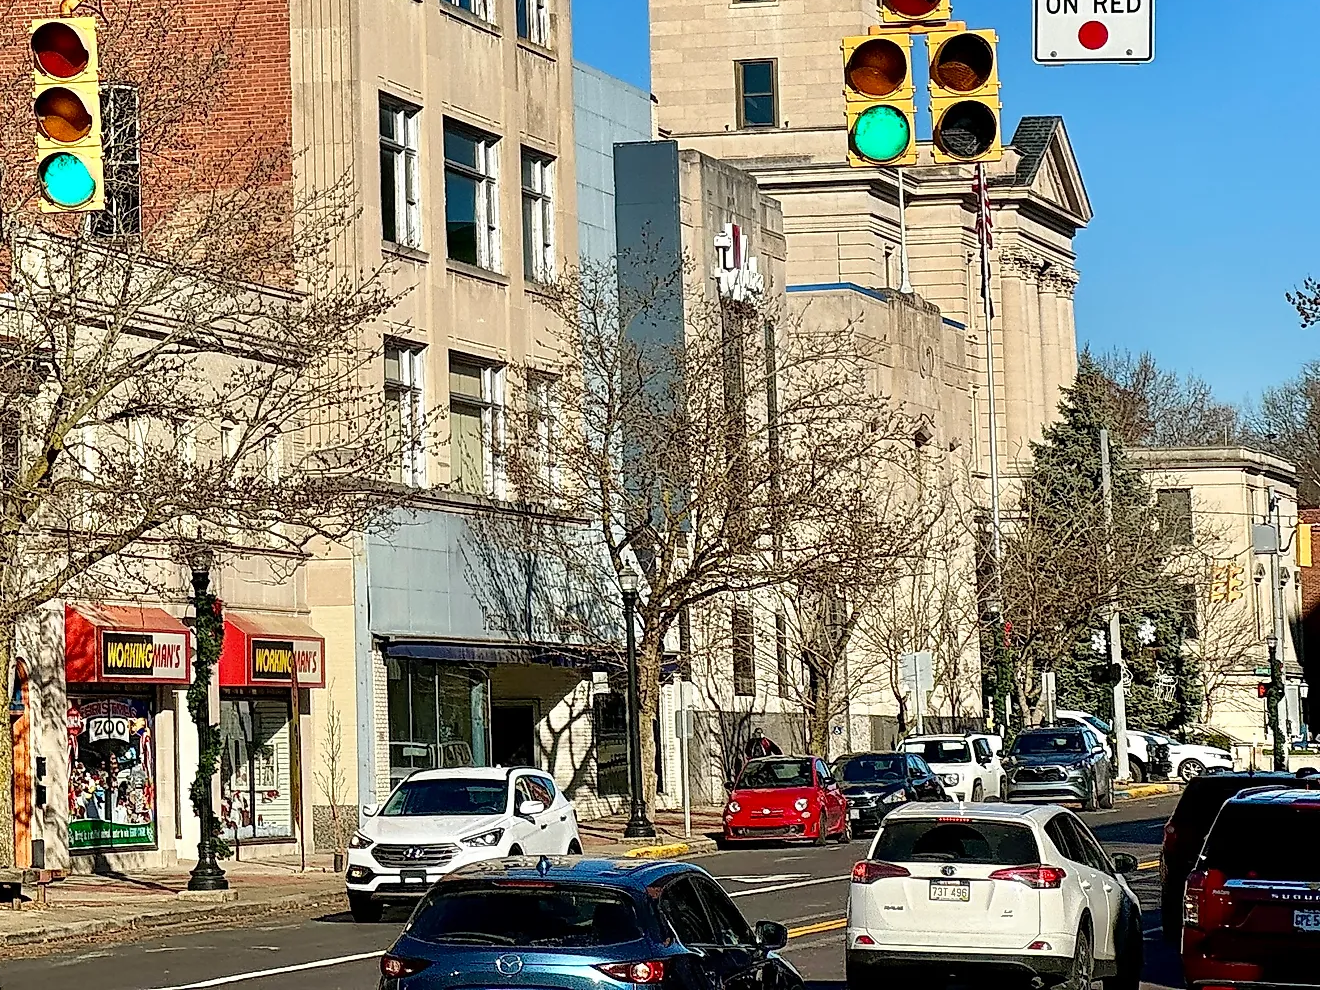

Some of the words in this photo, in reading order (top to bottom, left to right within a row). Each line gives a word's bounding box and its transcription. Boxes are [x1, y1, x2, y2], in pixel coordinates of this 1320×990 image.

[94, 719, 126, 736] ZOO
[932, 886, 948, 898] 73T
[950, 888, 968, 899] 496
